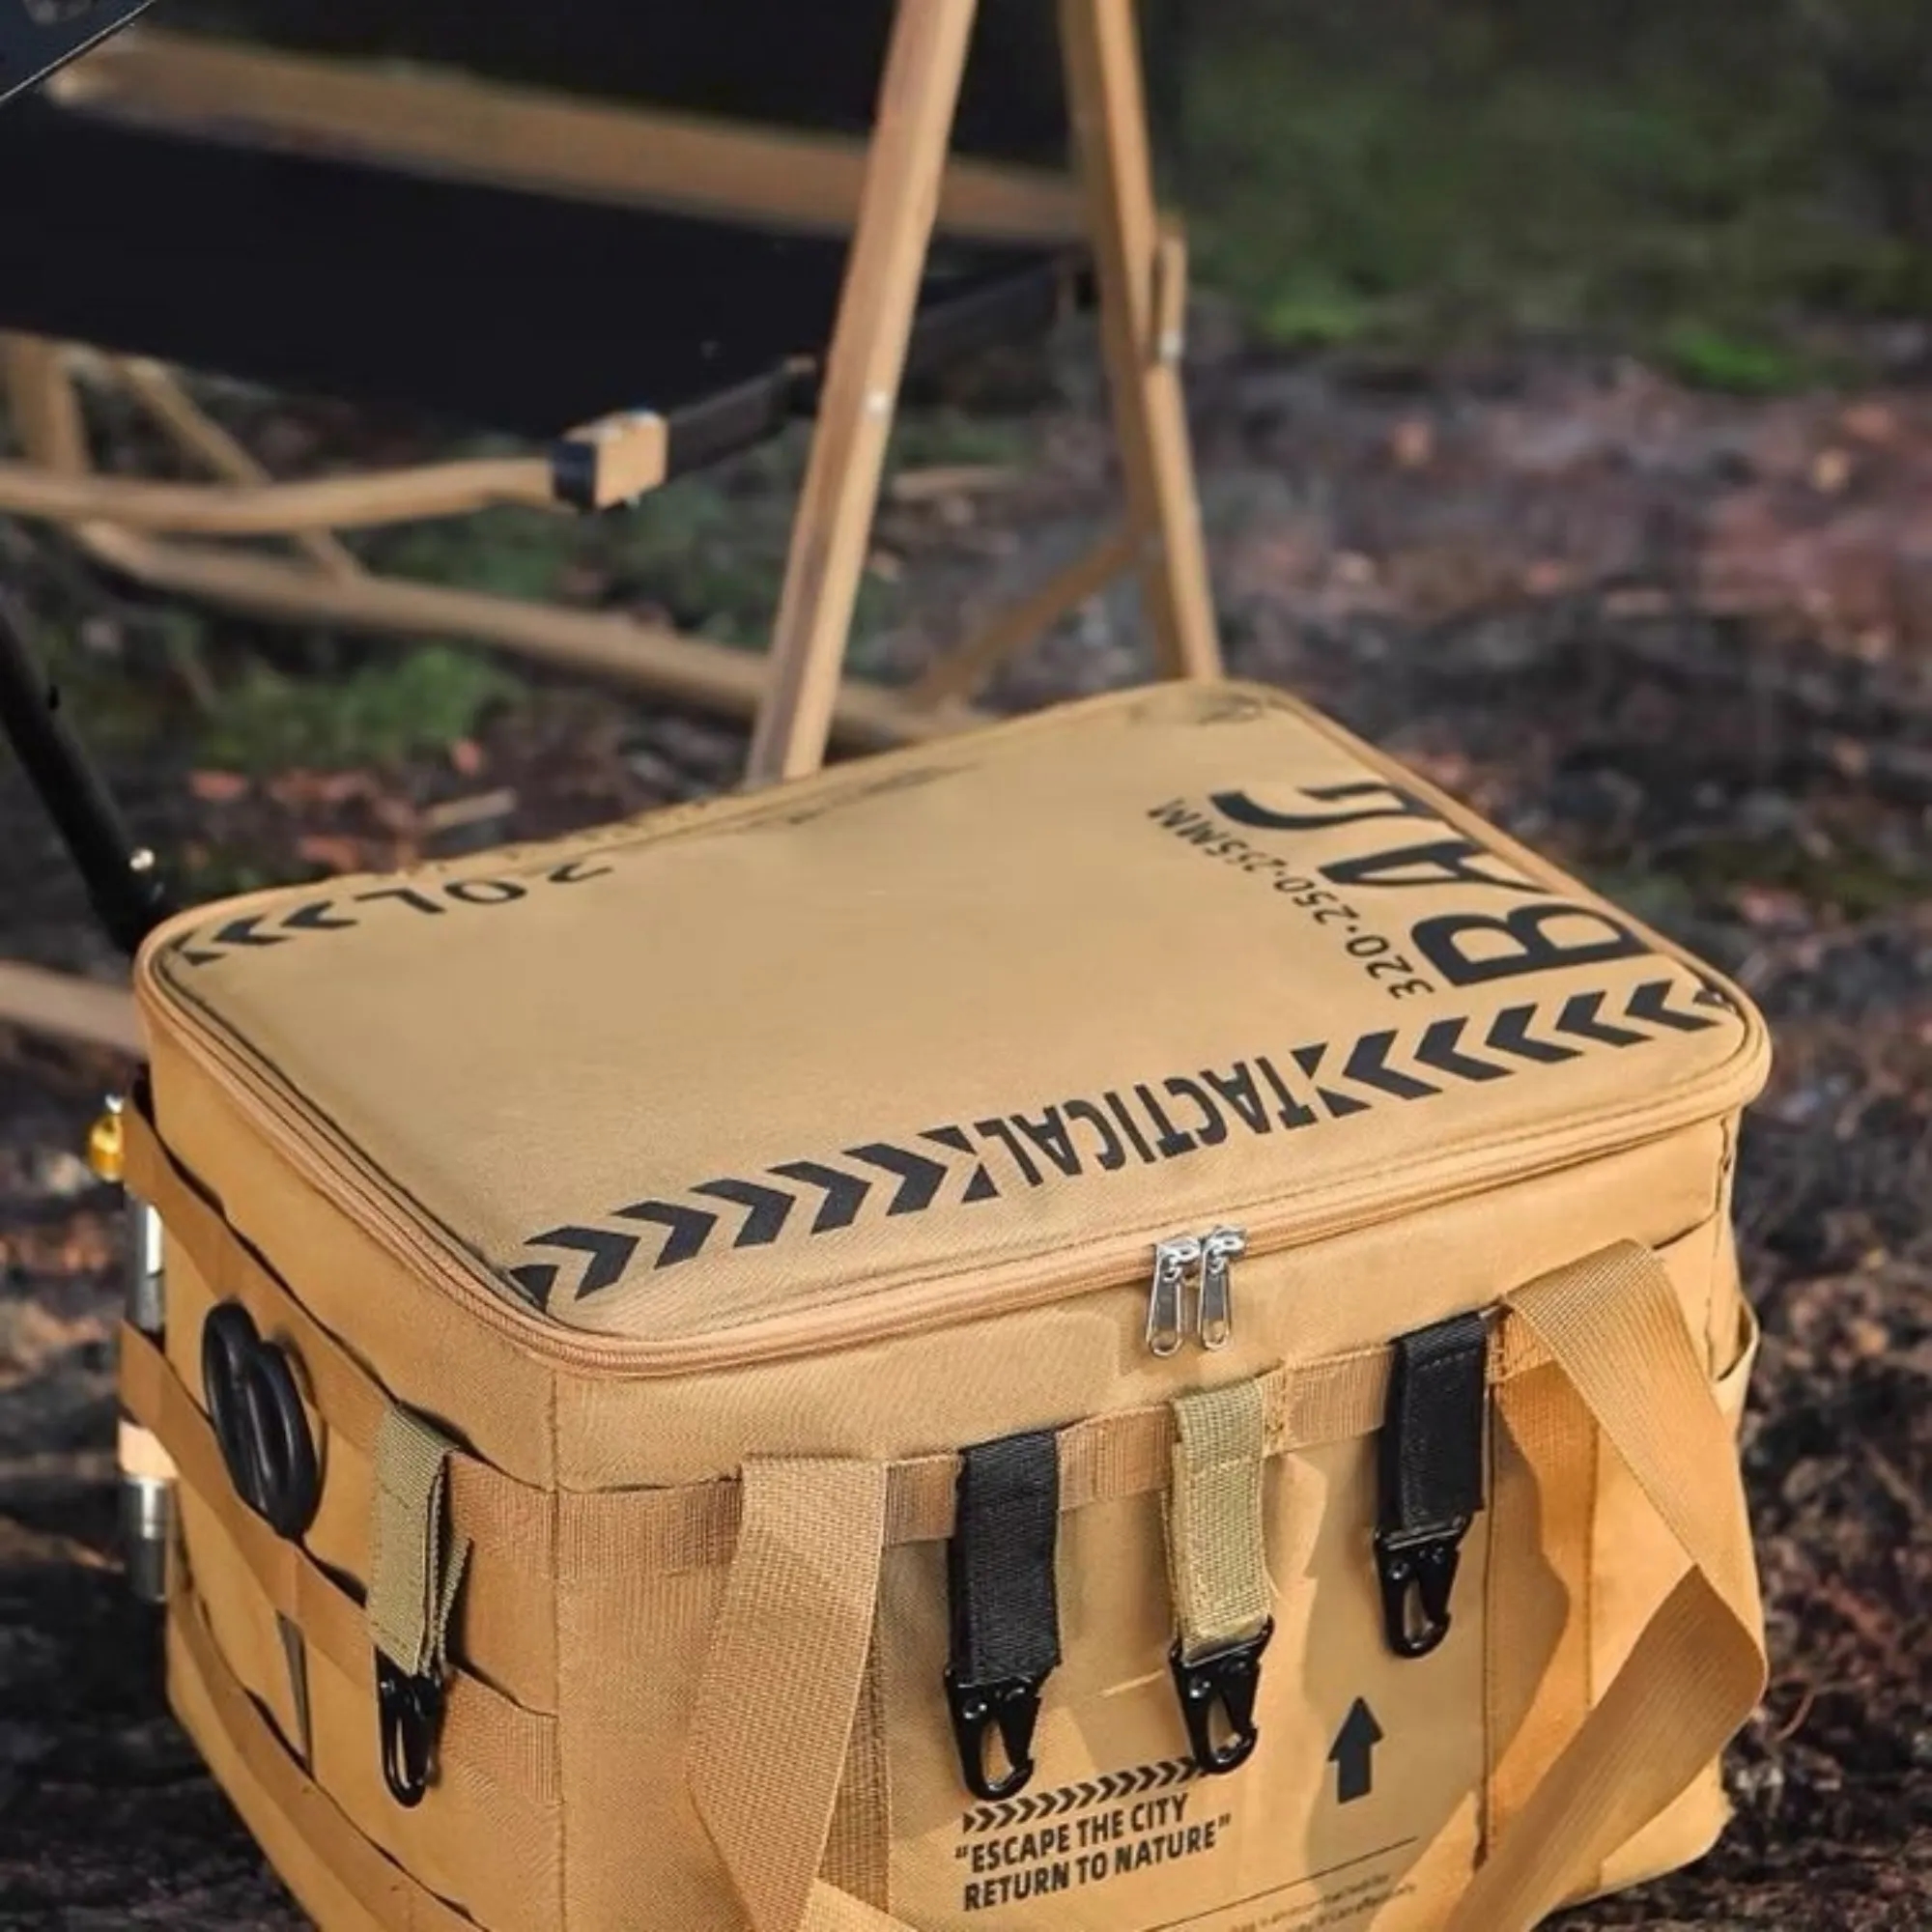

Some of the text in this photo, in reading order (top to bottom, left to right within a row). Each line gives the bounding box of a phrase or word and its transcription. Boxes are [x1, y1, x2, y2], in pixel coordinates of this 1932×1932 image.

[1209, 781, 1654, 987] BAG
[974, 1057, 1319, 1186] TACTICAL
[1077, 1809, 1125, 1848] THE
[1130, 1792, 1189, 1835] CITY
[963, 1861, 1068, 1912] RETURN
[1075, 1852, 1108, 1886] TO
